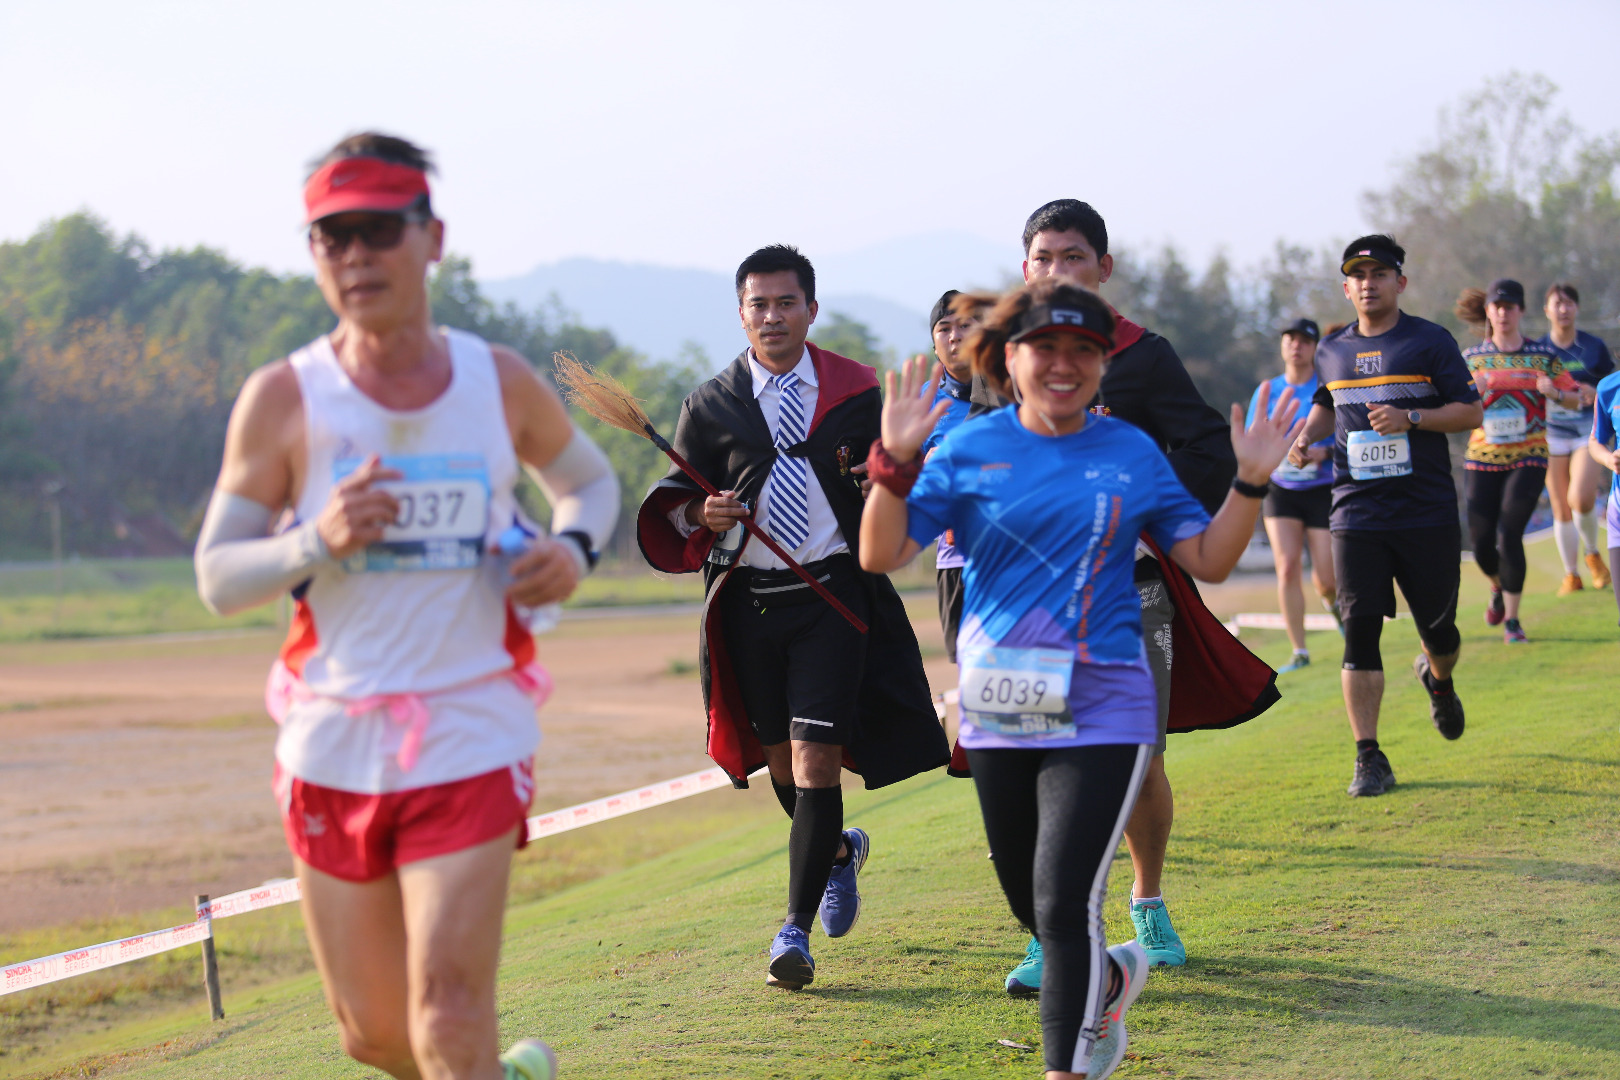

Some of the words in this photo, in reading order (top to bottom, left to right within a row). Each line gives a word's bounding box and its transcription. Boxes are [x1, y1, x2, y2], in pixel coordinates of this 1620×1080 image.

[1361, 443, 1397, 462] 6015
[394, 490, 466, 529] 037
[1092, 491, 1107, 534] CROSS
[981, 676, 1048, 707] 6039
[64, 950, 89, 963] SINGHA
[5, 965, 32, 979] SINGHA
[65, 959, 90, 973] SERIES
[6, 974, 33, 989] SERIES
